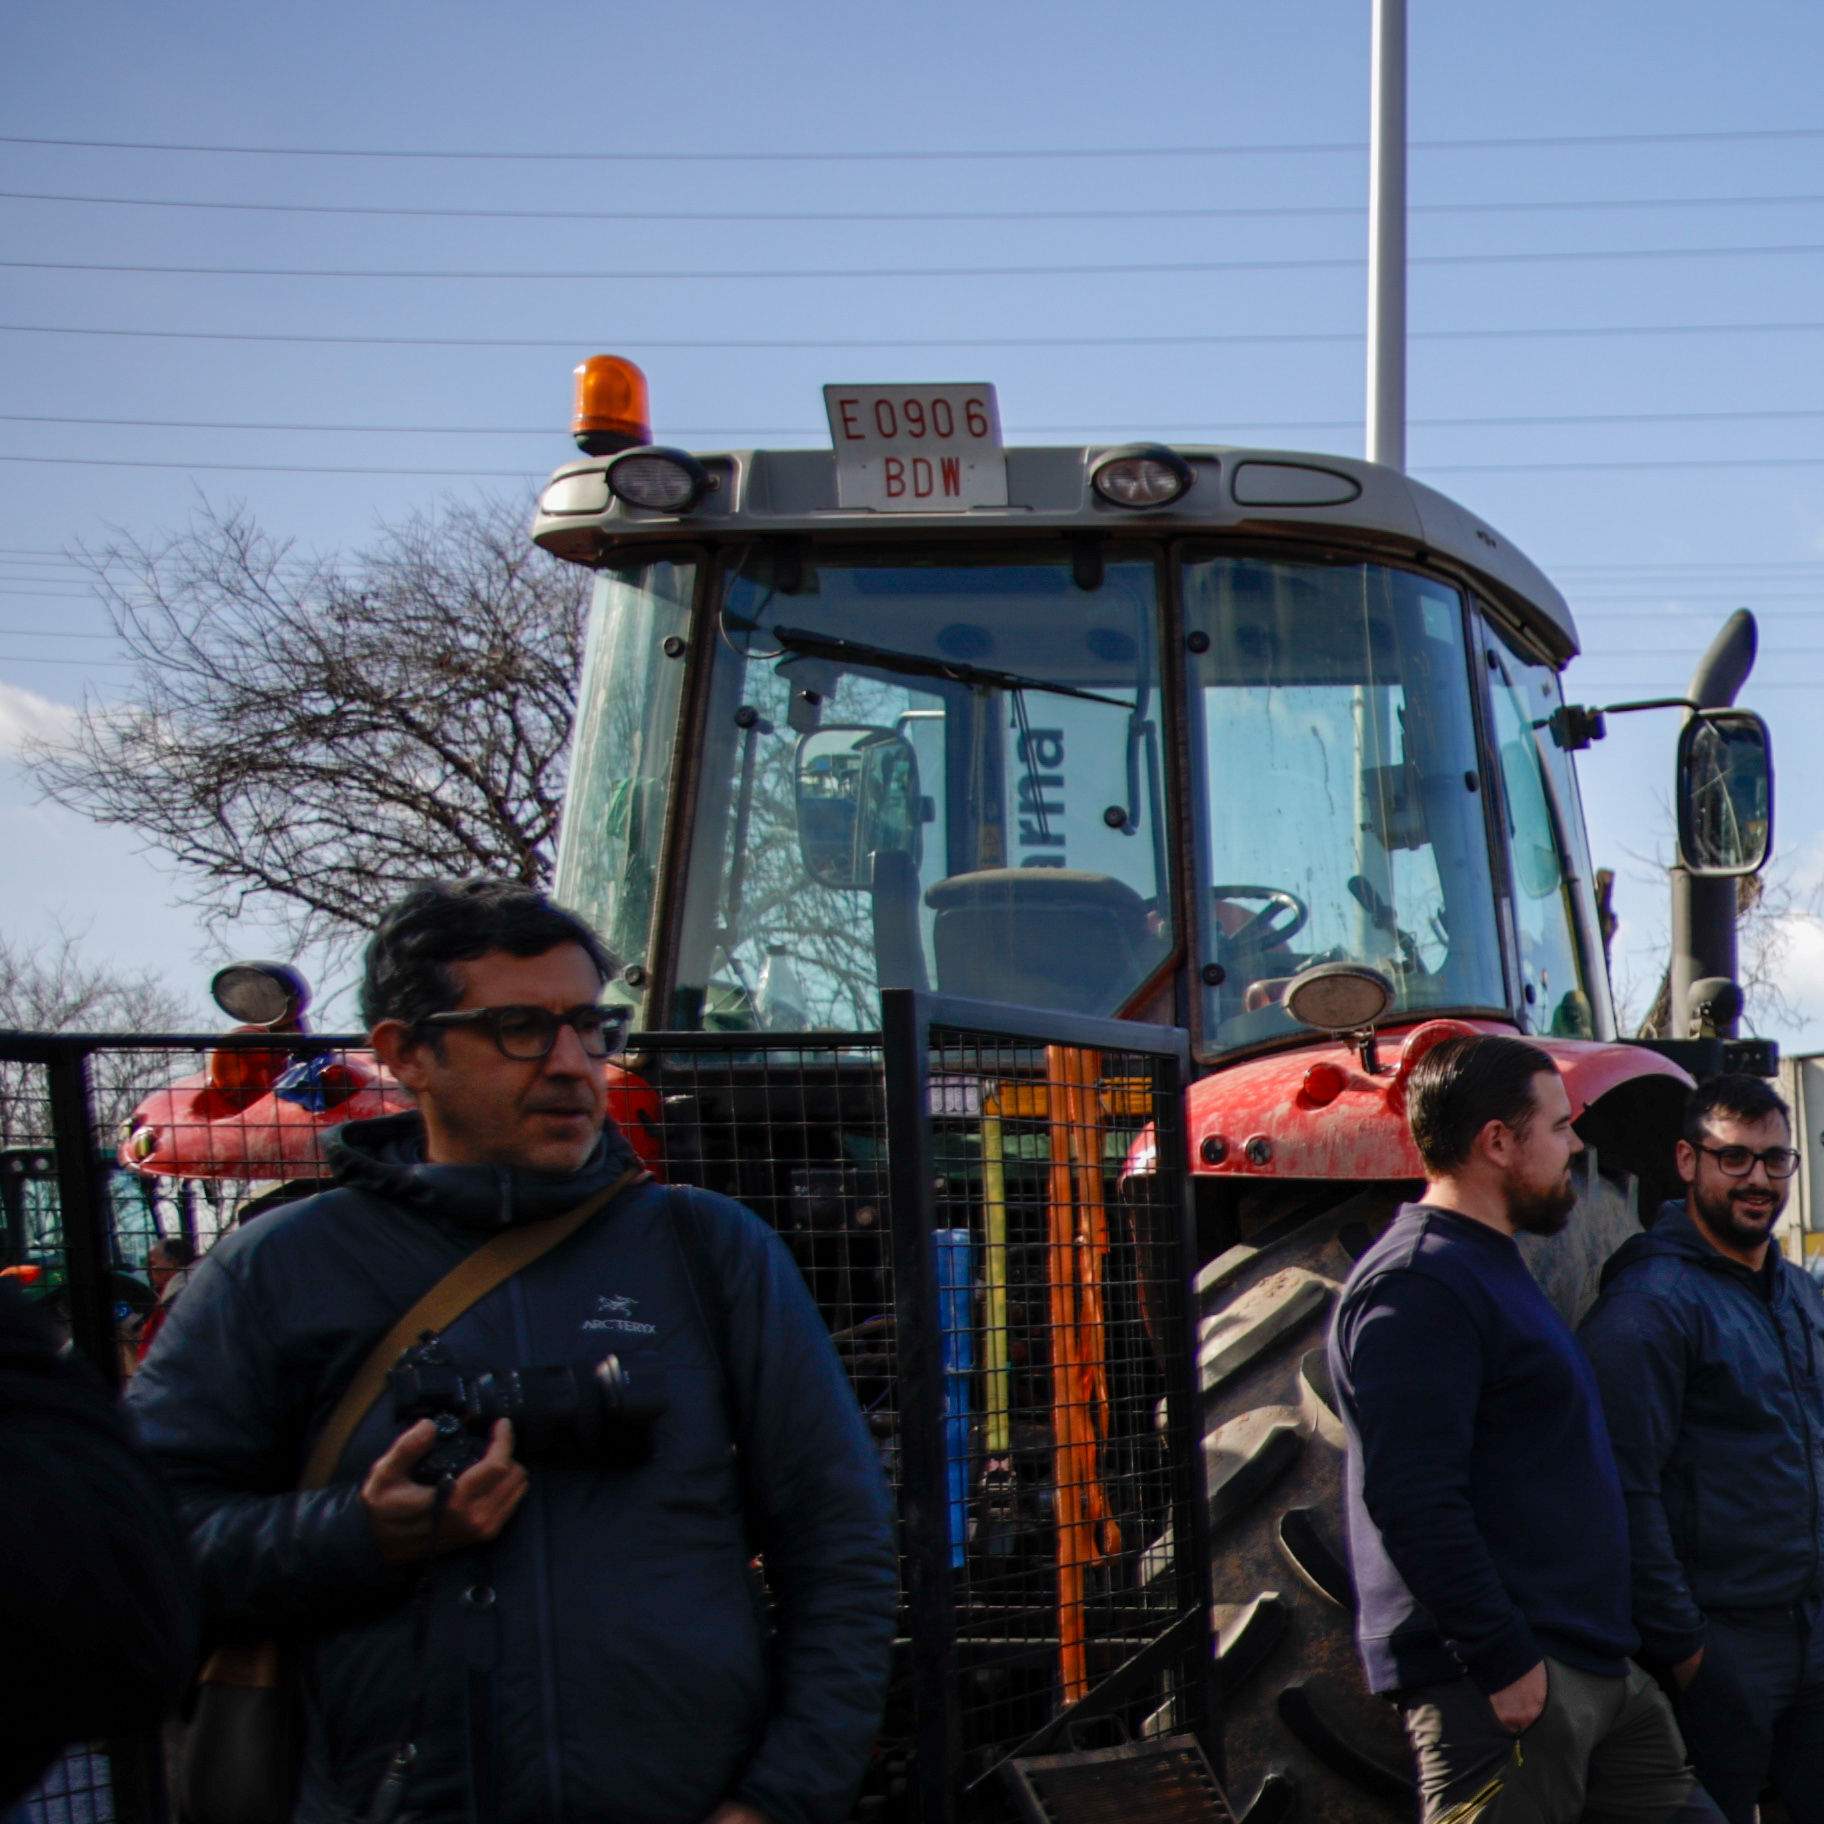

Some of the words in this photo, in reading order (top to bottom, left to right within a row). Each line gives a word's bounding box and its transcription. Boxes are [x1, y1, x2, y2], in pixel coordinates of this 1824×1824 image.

[839, 398, 989, 441] E0906
[884, 456, 961, 498] BDW
[1016, 728, 1066, 869] rna
